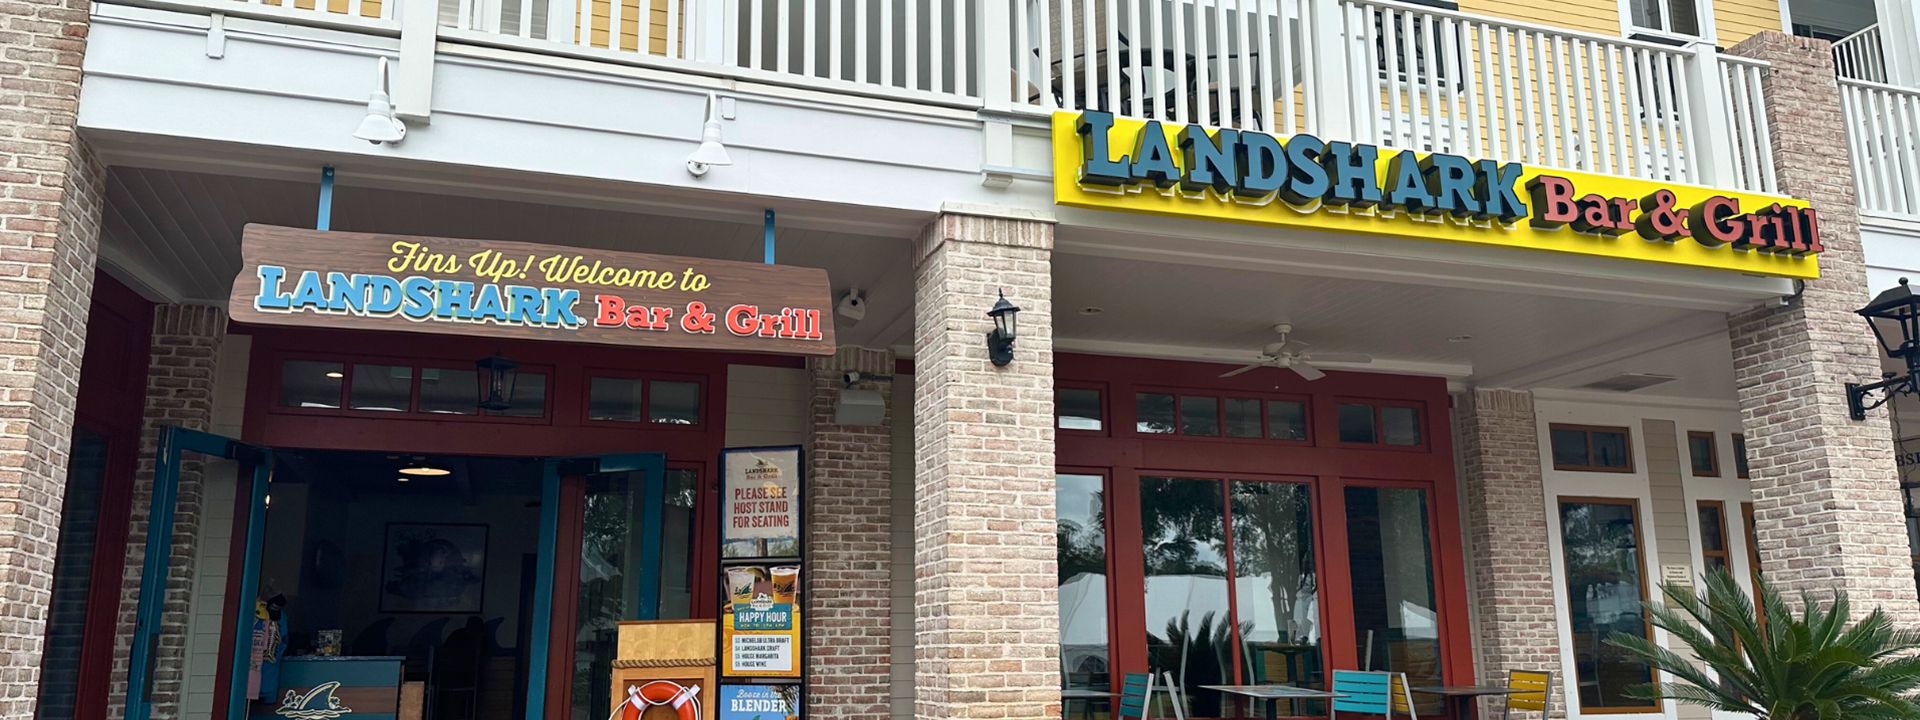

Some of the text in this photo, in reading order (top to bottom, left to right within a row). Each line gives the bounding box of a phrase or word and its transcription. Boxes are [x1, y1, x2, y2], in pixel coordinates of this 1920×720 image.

[1075, 108, 1825, 259] LANDSHARK Bar & Grill
[387, 240, 712, 292] Fins Up! Welcome to
[255, 263, 823, 341] LANDSHARK Bar & Grill
[735, 486, 787, 500] PLEASE SEE
[733, 501, 788, 514] HOST STAND
[732, 515, 789, 529] FOR SEATING
[739, 611, 787, 623] HAPPY HOUR
[731, 699, 787, 712] BLENDER
